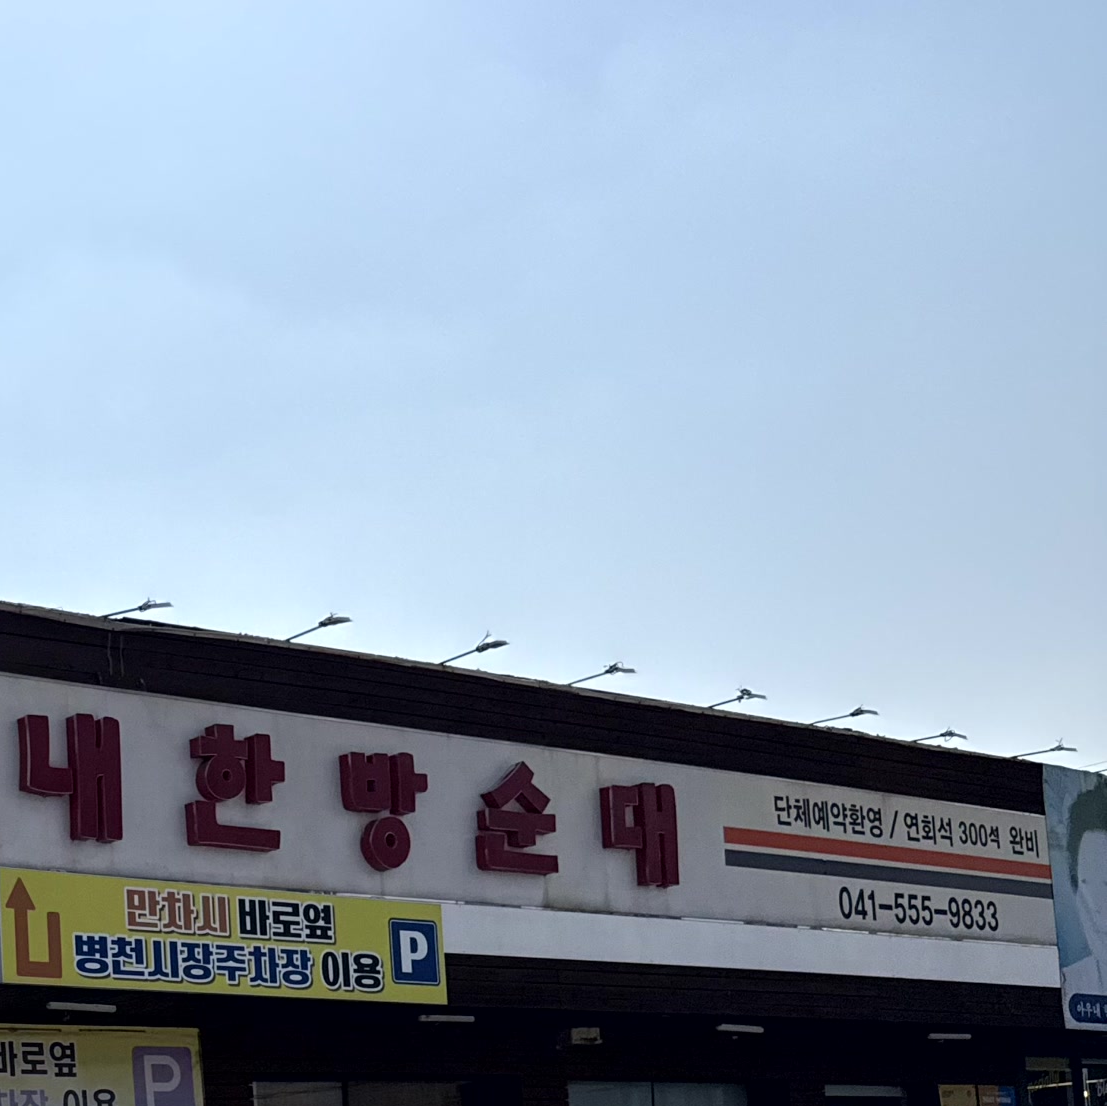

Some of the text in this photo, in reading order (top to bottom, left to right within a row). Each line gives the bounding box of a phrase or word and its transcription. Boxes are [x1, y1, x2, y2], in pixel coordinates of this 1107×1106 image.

[774, 795, 882, 838] 단체예약환영
[903, 812, 954, 847] 연회석
[959, 820, 1001, 849] 300석
[1009, 826, 1039, 858] 완비
[124, 886, 334, 943] 만차시 바로옆
[839, 886, 999, 932] 041-555-9833
[74, 934, 384, 991] 병천시장주차장 이용
